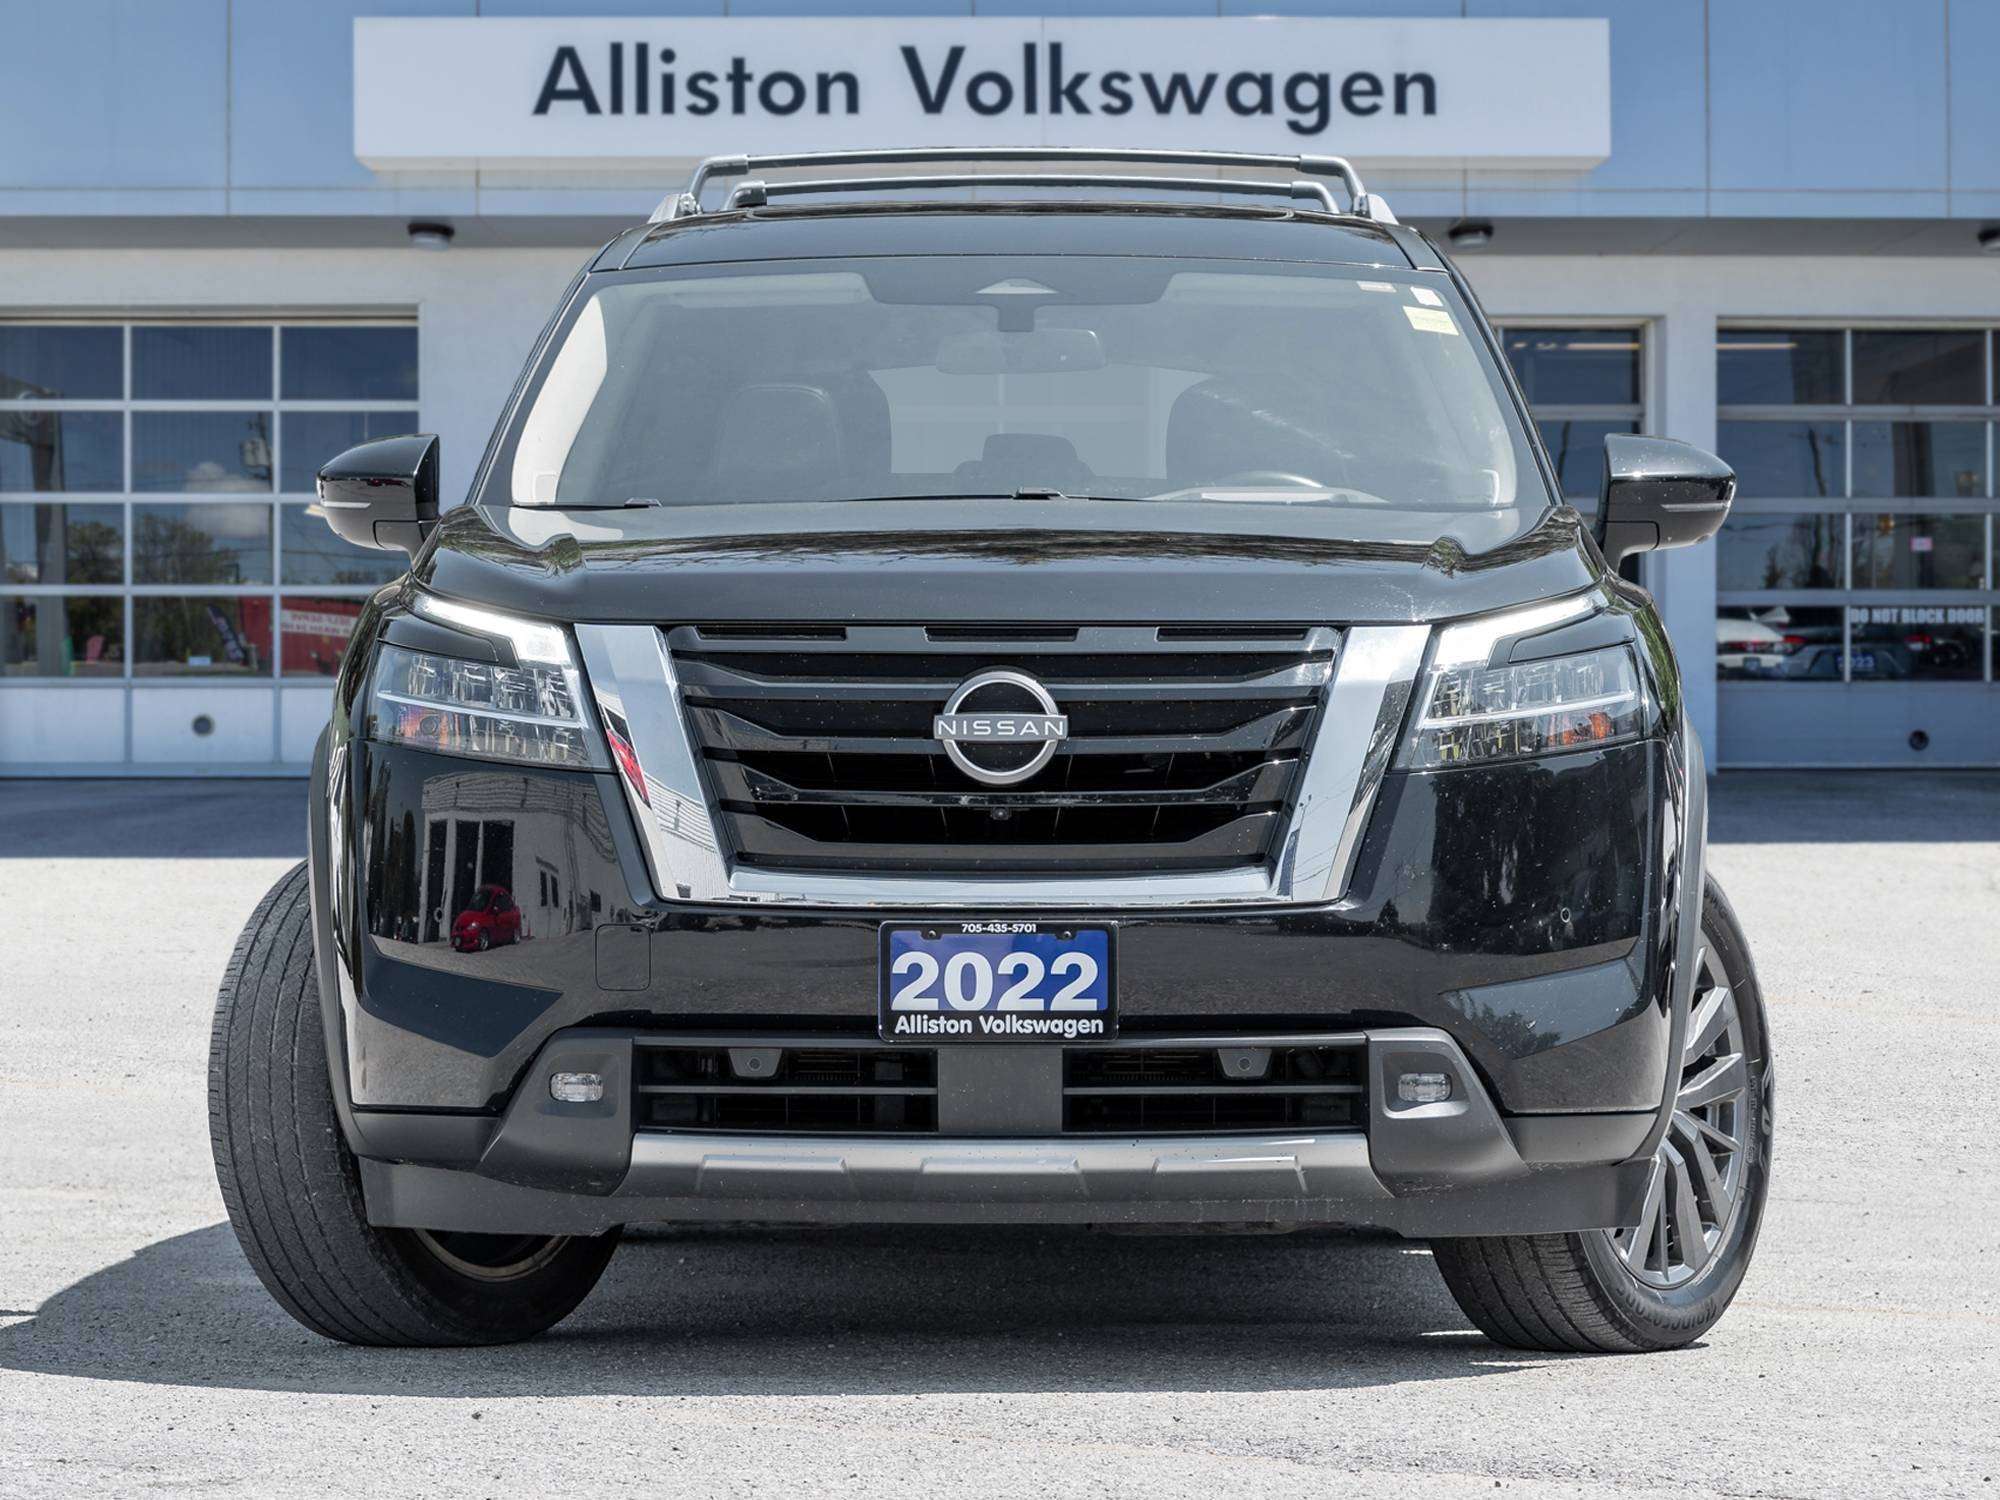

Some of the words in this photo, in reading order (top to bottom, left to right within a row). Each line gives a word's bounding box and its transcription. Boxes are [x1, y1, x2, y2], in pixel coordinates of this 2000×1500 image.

[532, 42, 860, 116] Alliston
[900, 42, 1438, 136] Volkswagen
[1849, 608, 1869, 623] DO
[1872, 608, 1898, 623] NOT
[1901, 608, 1944, 623] BLOCK
[1947, 608, 1985, 623] DOOR
[938, 720, 1064, 736] NISSAN
[961, 923, 1037, 934] 705-435-5701
[891, 951, 1099, 1011] 2022
[894, 1015, 973, 1035] Alliston
[979, 1015, 1104, 1038] Volkswagen
